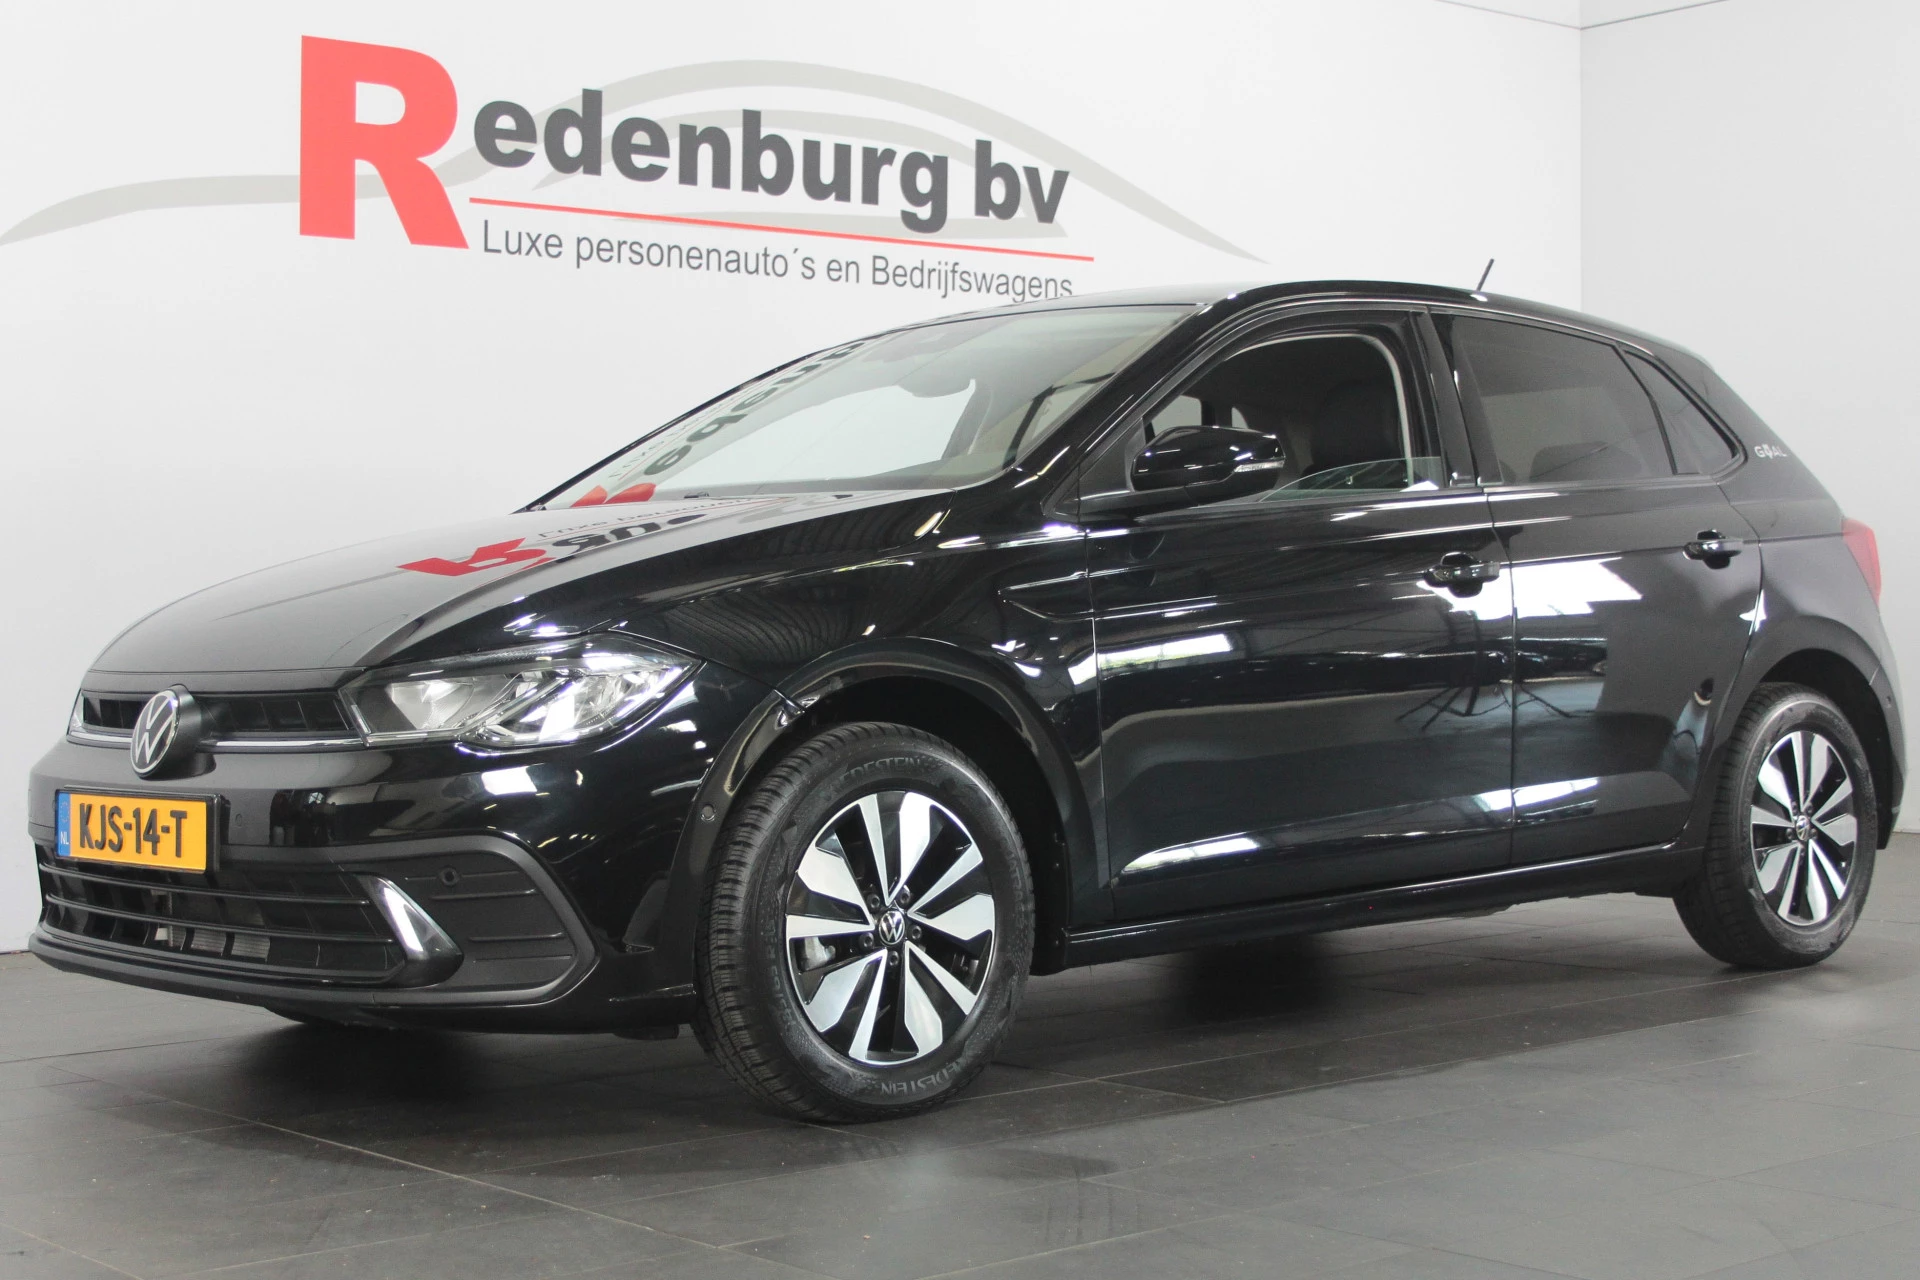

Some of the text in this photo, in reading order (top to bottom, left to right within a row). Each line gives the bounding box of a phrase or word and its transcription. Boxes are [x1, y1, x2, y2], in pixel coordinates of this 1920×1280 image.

[299, 35, 1070, 249] Redenburg bv
[483, 219, 563, 259] Luxe
[826, 259, 860, 284] en
[872, 255, 1073, 303] Bedrijfswagens
[60, 831, 70, 845] NL
[79, 803, 188, 858] KJS-14-T
